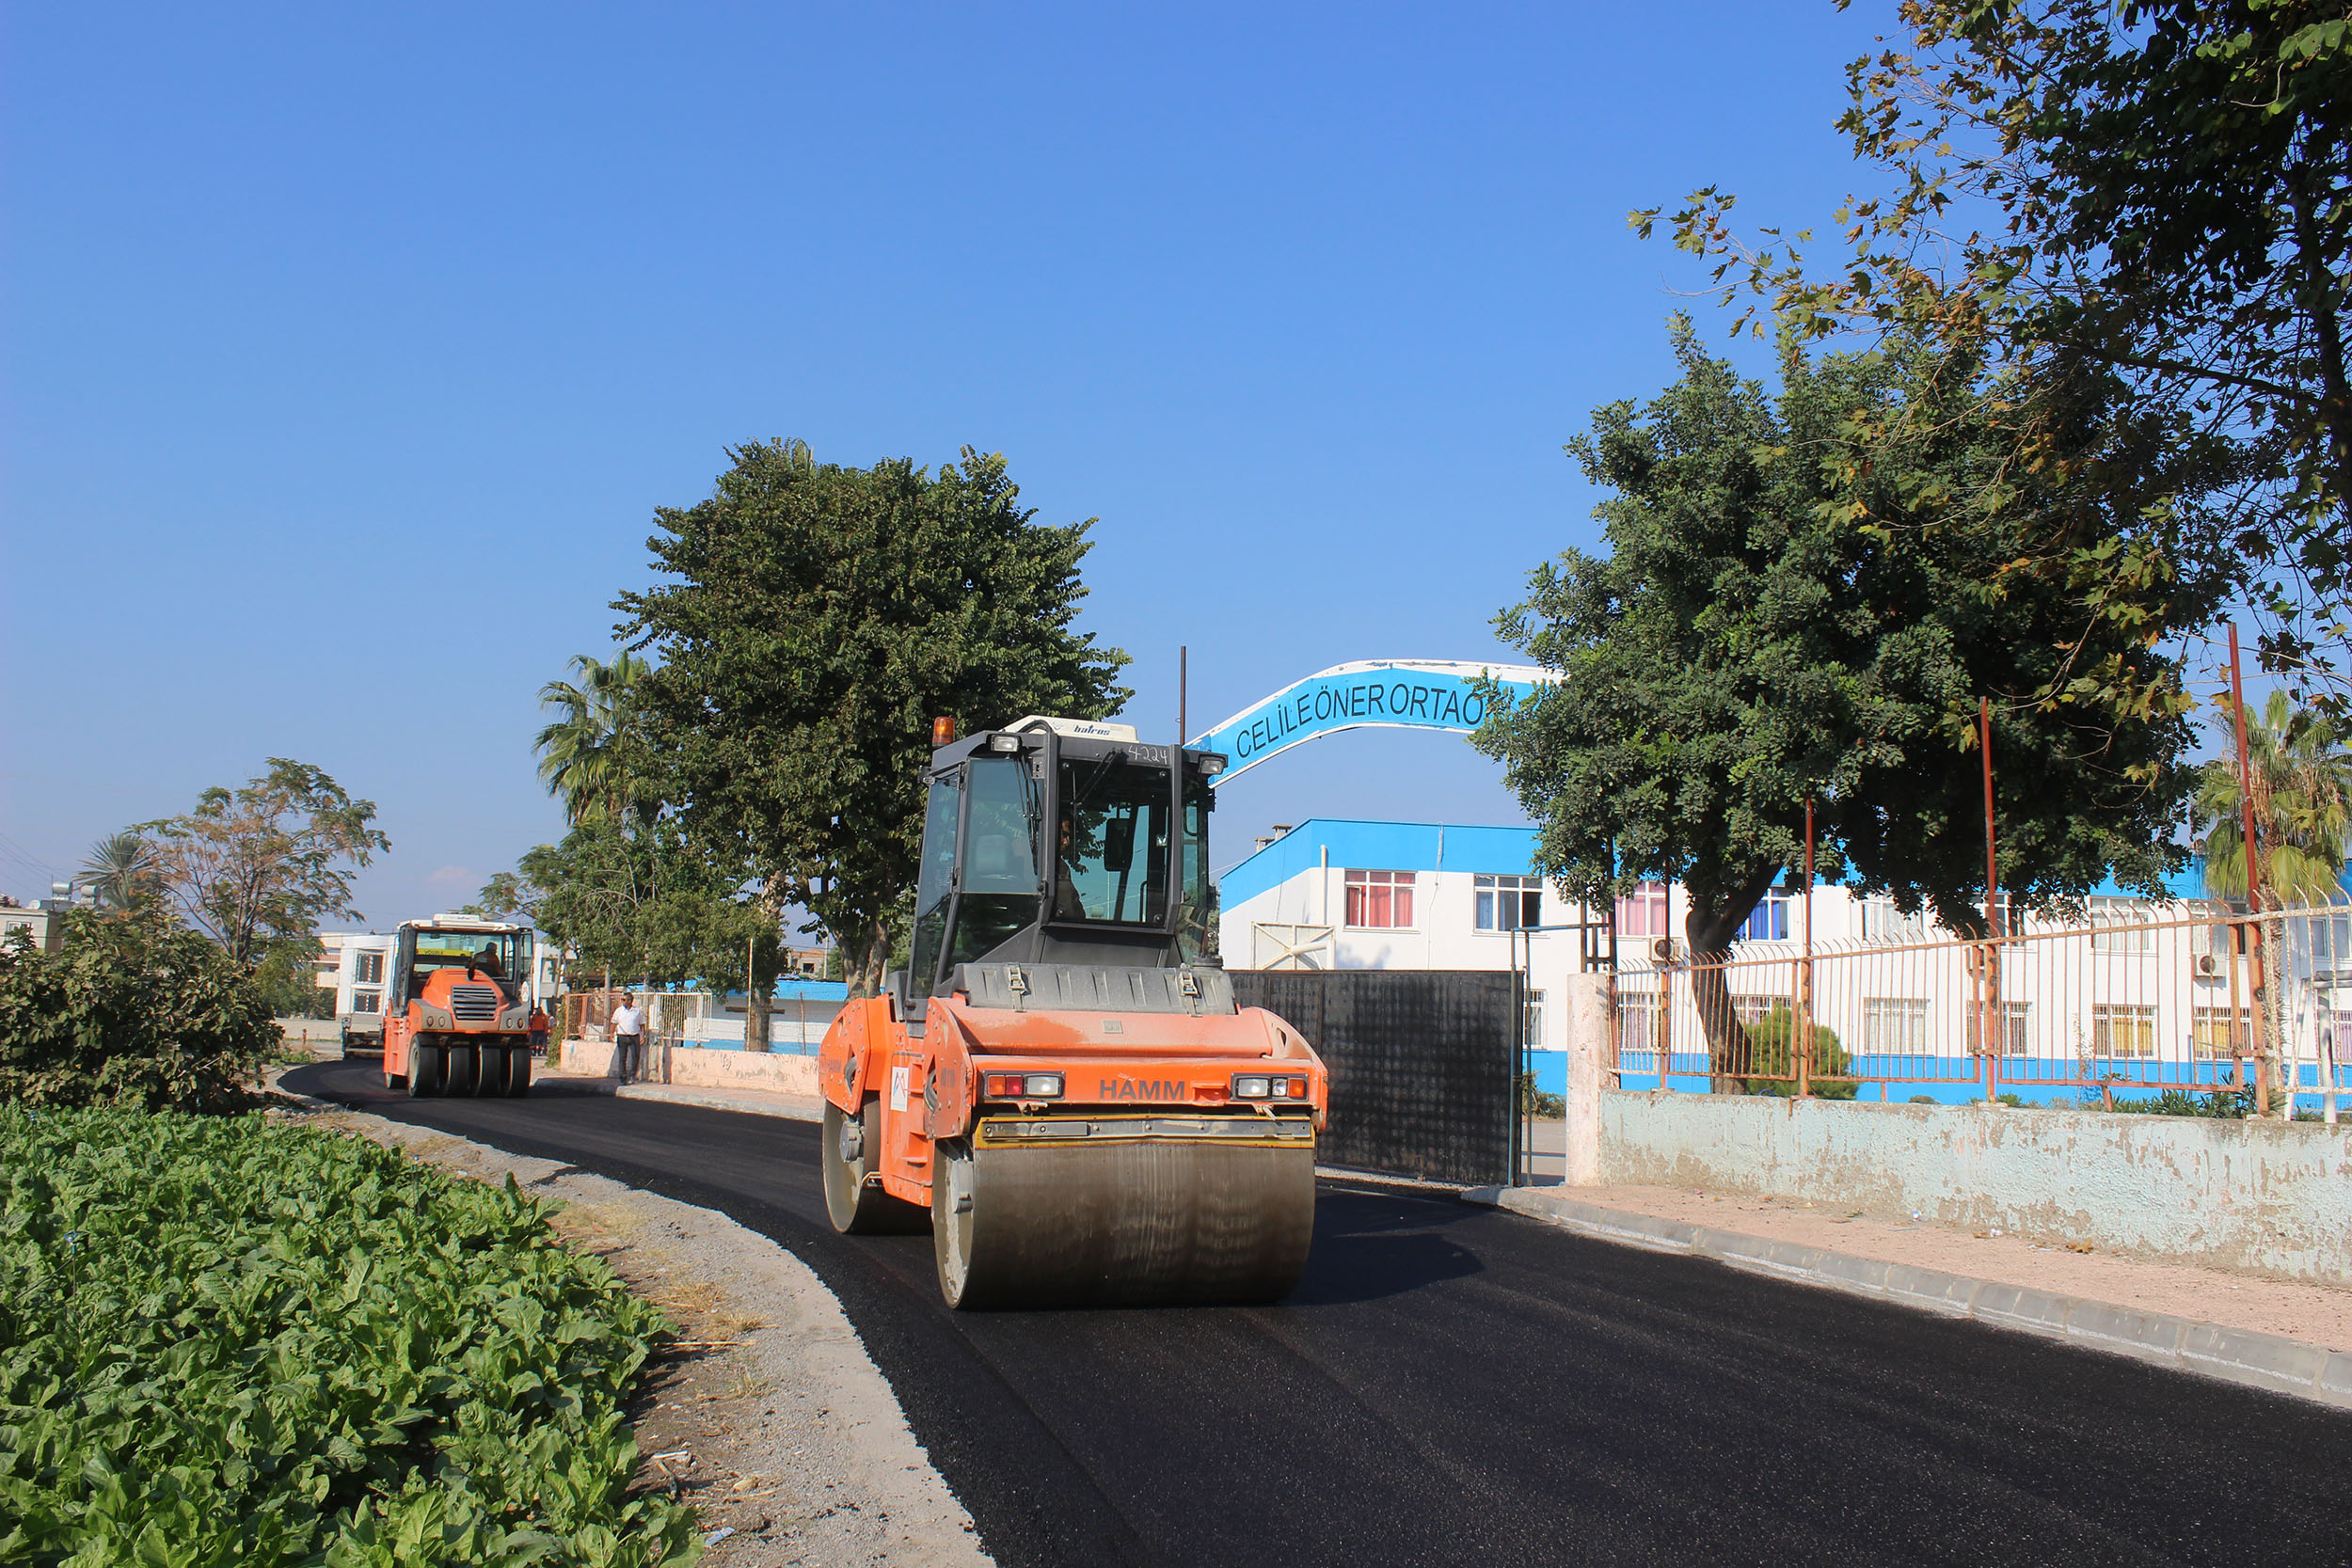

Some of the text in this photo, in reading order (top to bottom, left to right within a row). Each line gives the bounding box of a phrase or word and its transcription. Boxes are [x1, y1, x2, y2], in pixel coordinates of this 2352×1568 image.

[1236, 683, 1484, 758] CELİLE ÖNER ORTAO
[1129, 745, 1168, 766] 4224
[1099, 1079, 1185, 1101] HAMM
